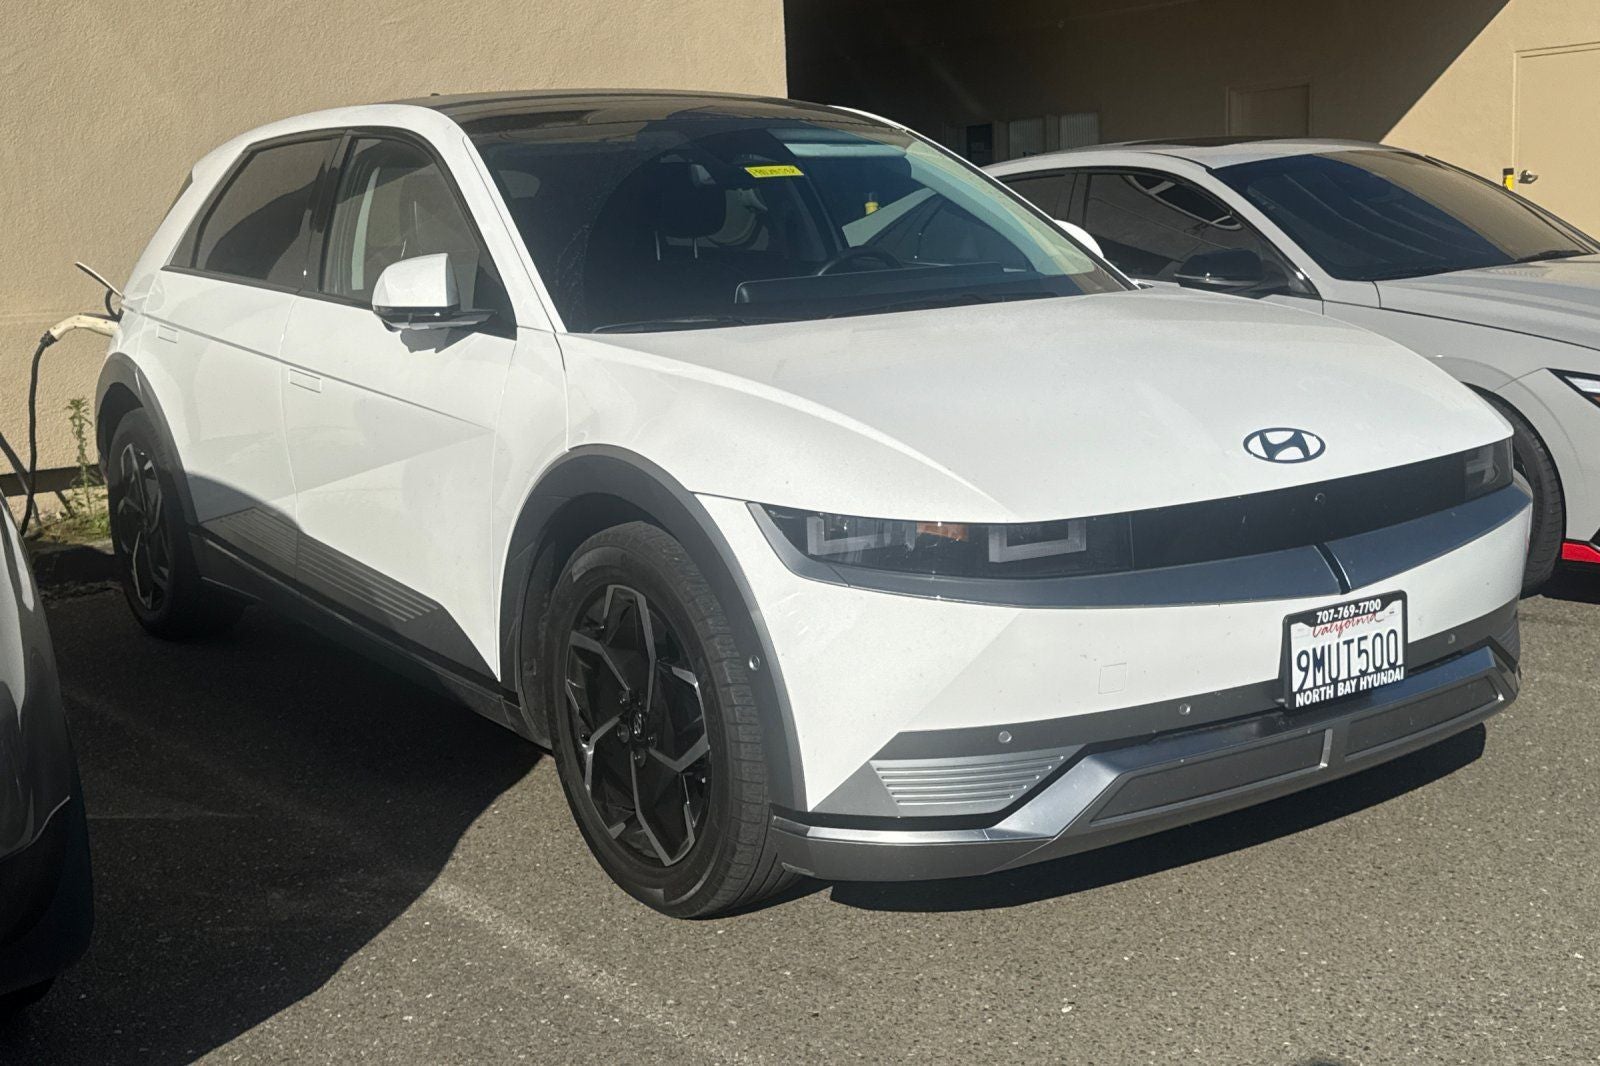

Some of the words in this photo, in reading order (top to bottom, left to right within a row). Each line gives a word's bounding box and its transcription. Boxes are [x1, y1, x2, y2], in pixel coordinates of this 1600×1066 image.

[1312, 612, 1384, 638] California
[1316, 598, 1382, 624] 707-769-7700
[1296, 629, 1398, 692] 9MUT500
[1295, 684, 1334, 708] NORTH
[1337, 678, 1358, 697] BAY
[1359, 666, 1405, 691] HYUNDAI
